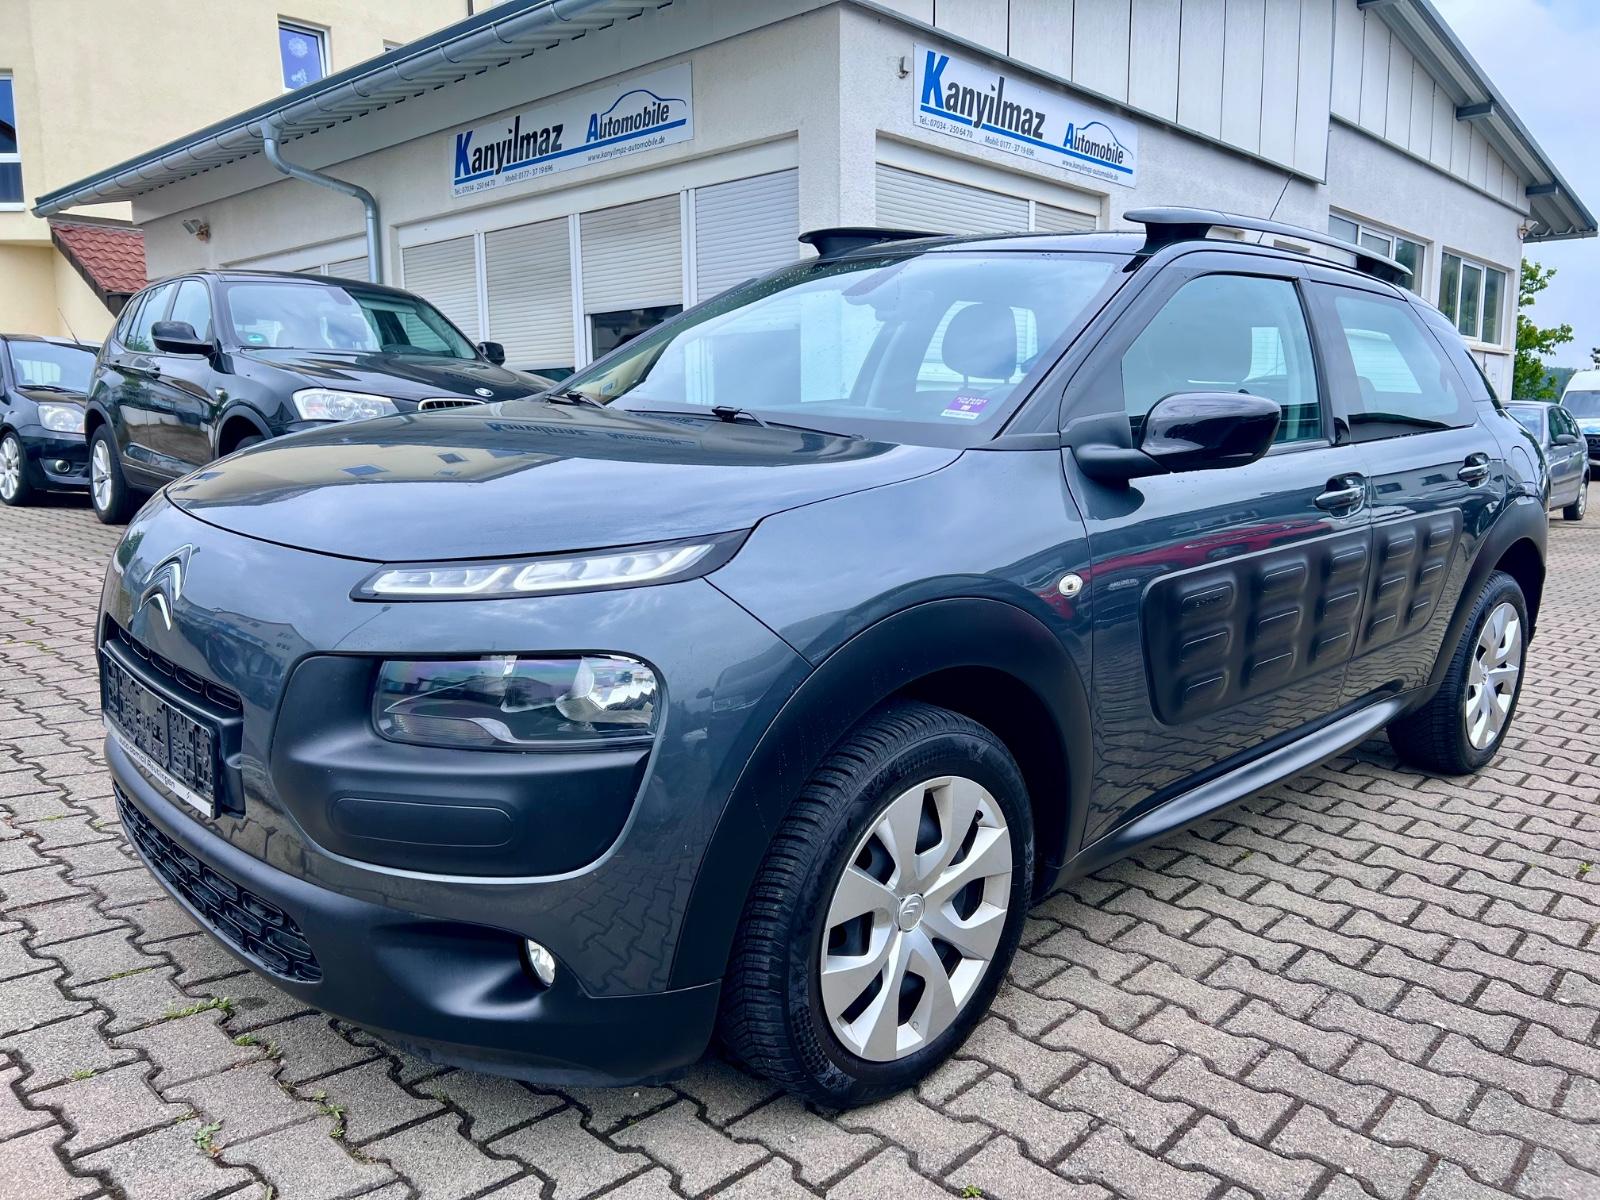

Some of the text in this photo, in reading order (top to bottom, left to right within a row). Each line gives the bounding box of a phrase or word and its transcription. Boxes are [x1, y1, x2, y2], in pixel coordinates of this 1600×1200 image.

[921, 50, 1046, 140] Kanyilmaz
[586, 101, 669, 143] Automobile
[930, 119, 946, 130] 07034
[454, 116, 563, 178] Kanyilmaz
[588, 135, 666, 161] www.kanyilmaz-automobile.de
[1063, 122, 1124, 165] Automobile
